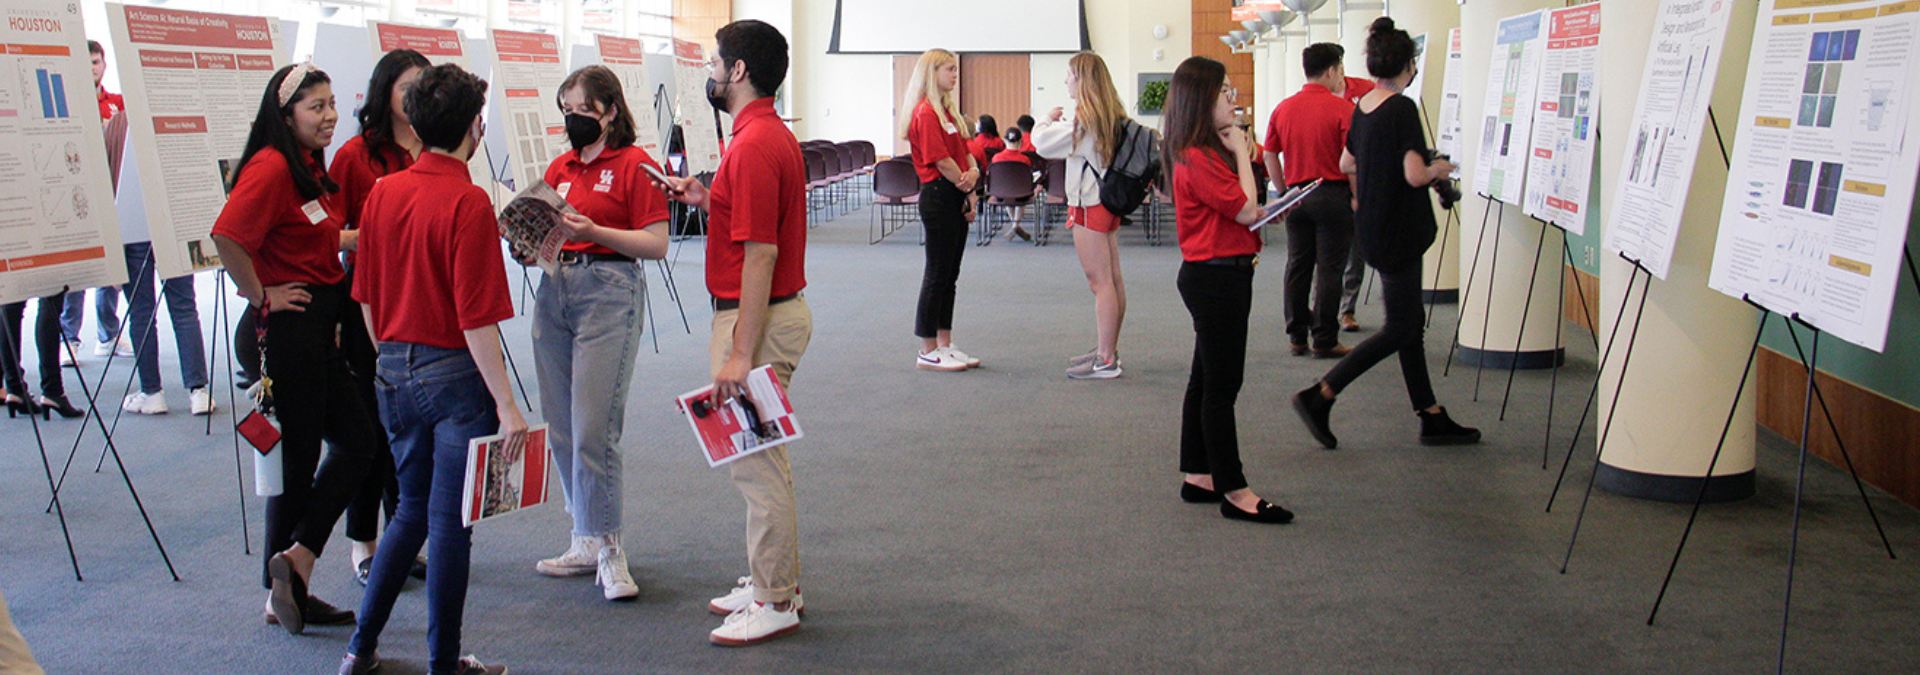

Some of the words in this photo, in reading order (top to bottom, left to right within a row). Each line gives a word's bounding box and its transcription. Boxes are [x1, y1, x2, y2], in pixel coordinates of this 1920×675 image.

[67, 3, 77, 15] 49
[8, 17, 62, 32] HOUSTON
[129, 11, 138, 20] Art
[139, 12, 159, 22] Science
[168, 14, 185, 24] Neural
[186, 15, 199, 26] Basis
[200, 17, 205, 26] of
[205, 17, 229, 29] Creativity
[236, 30, 268, 41] HOUSTON
